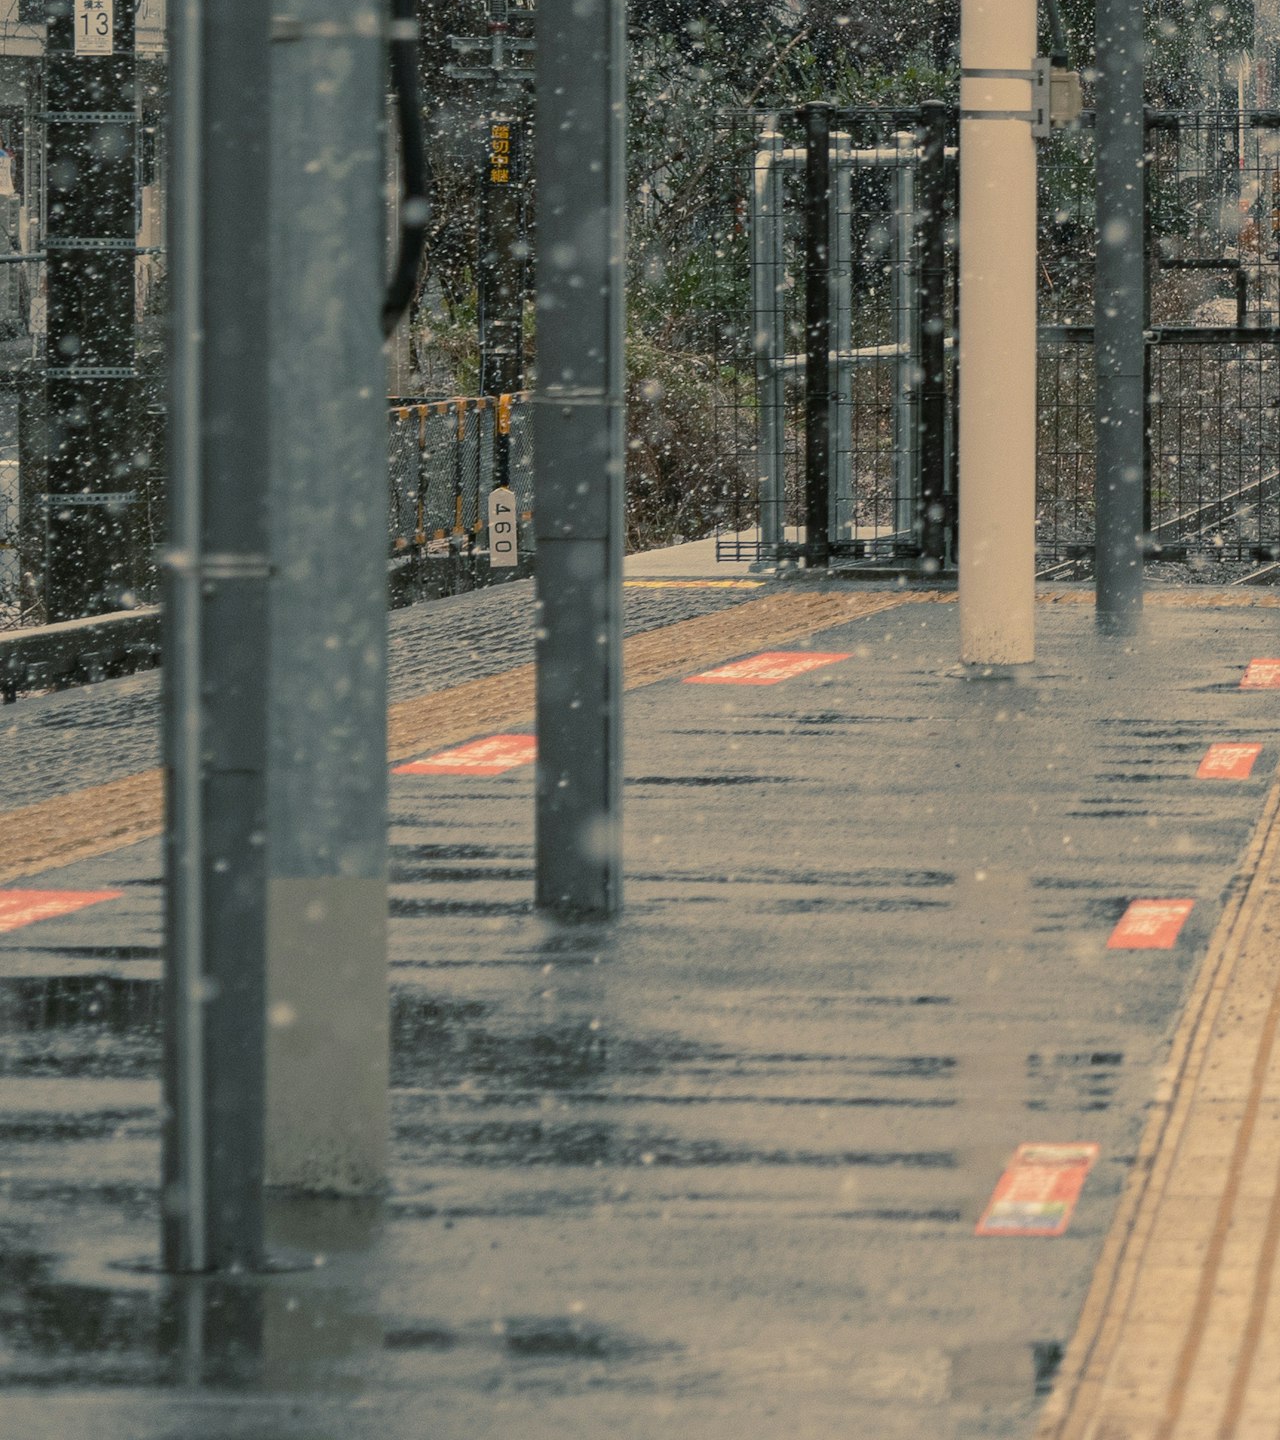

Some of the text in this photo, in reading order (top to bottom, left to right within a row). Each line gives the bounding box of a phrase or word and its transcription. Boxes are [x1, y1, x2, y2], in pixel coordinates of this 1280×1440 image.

[80, 12, 108, 35] 13
[491, 125, 509, 183] 踏切中継
[494, 503, 512, 553] 460
